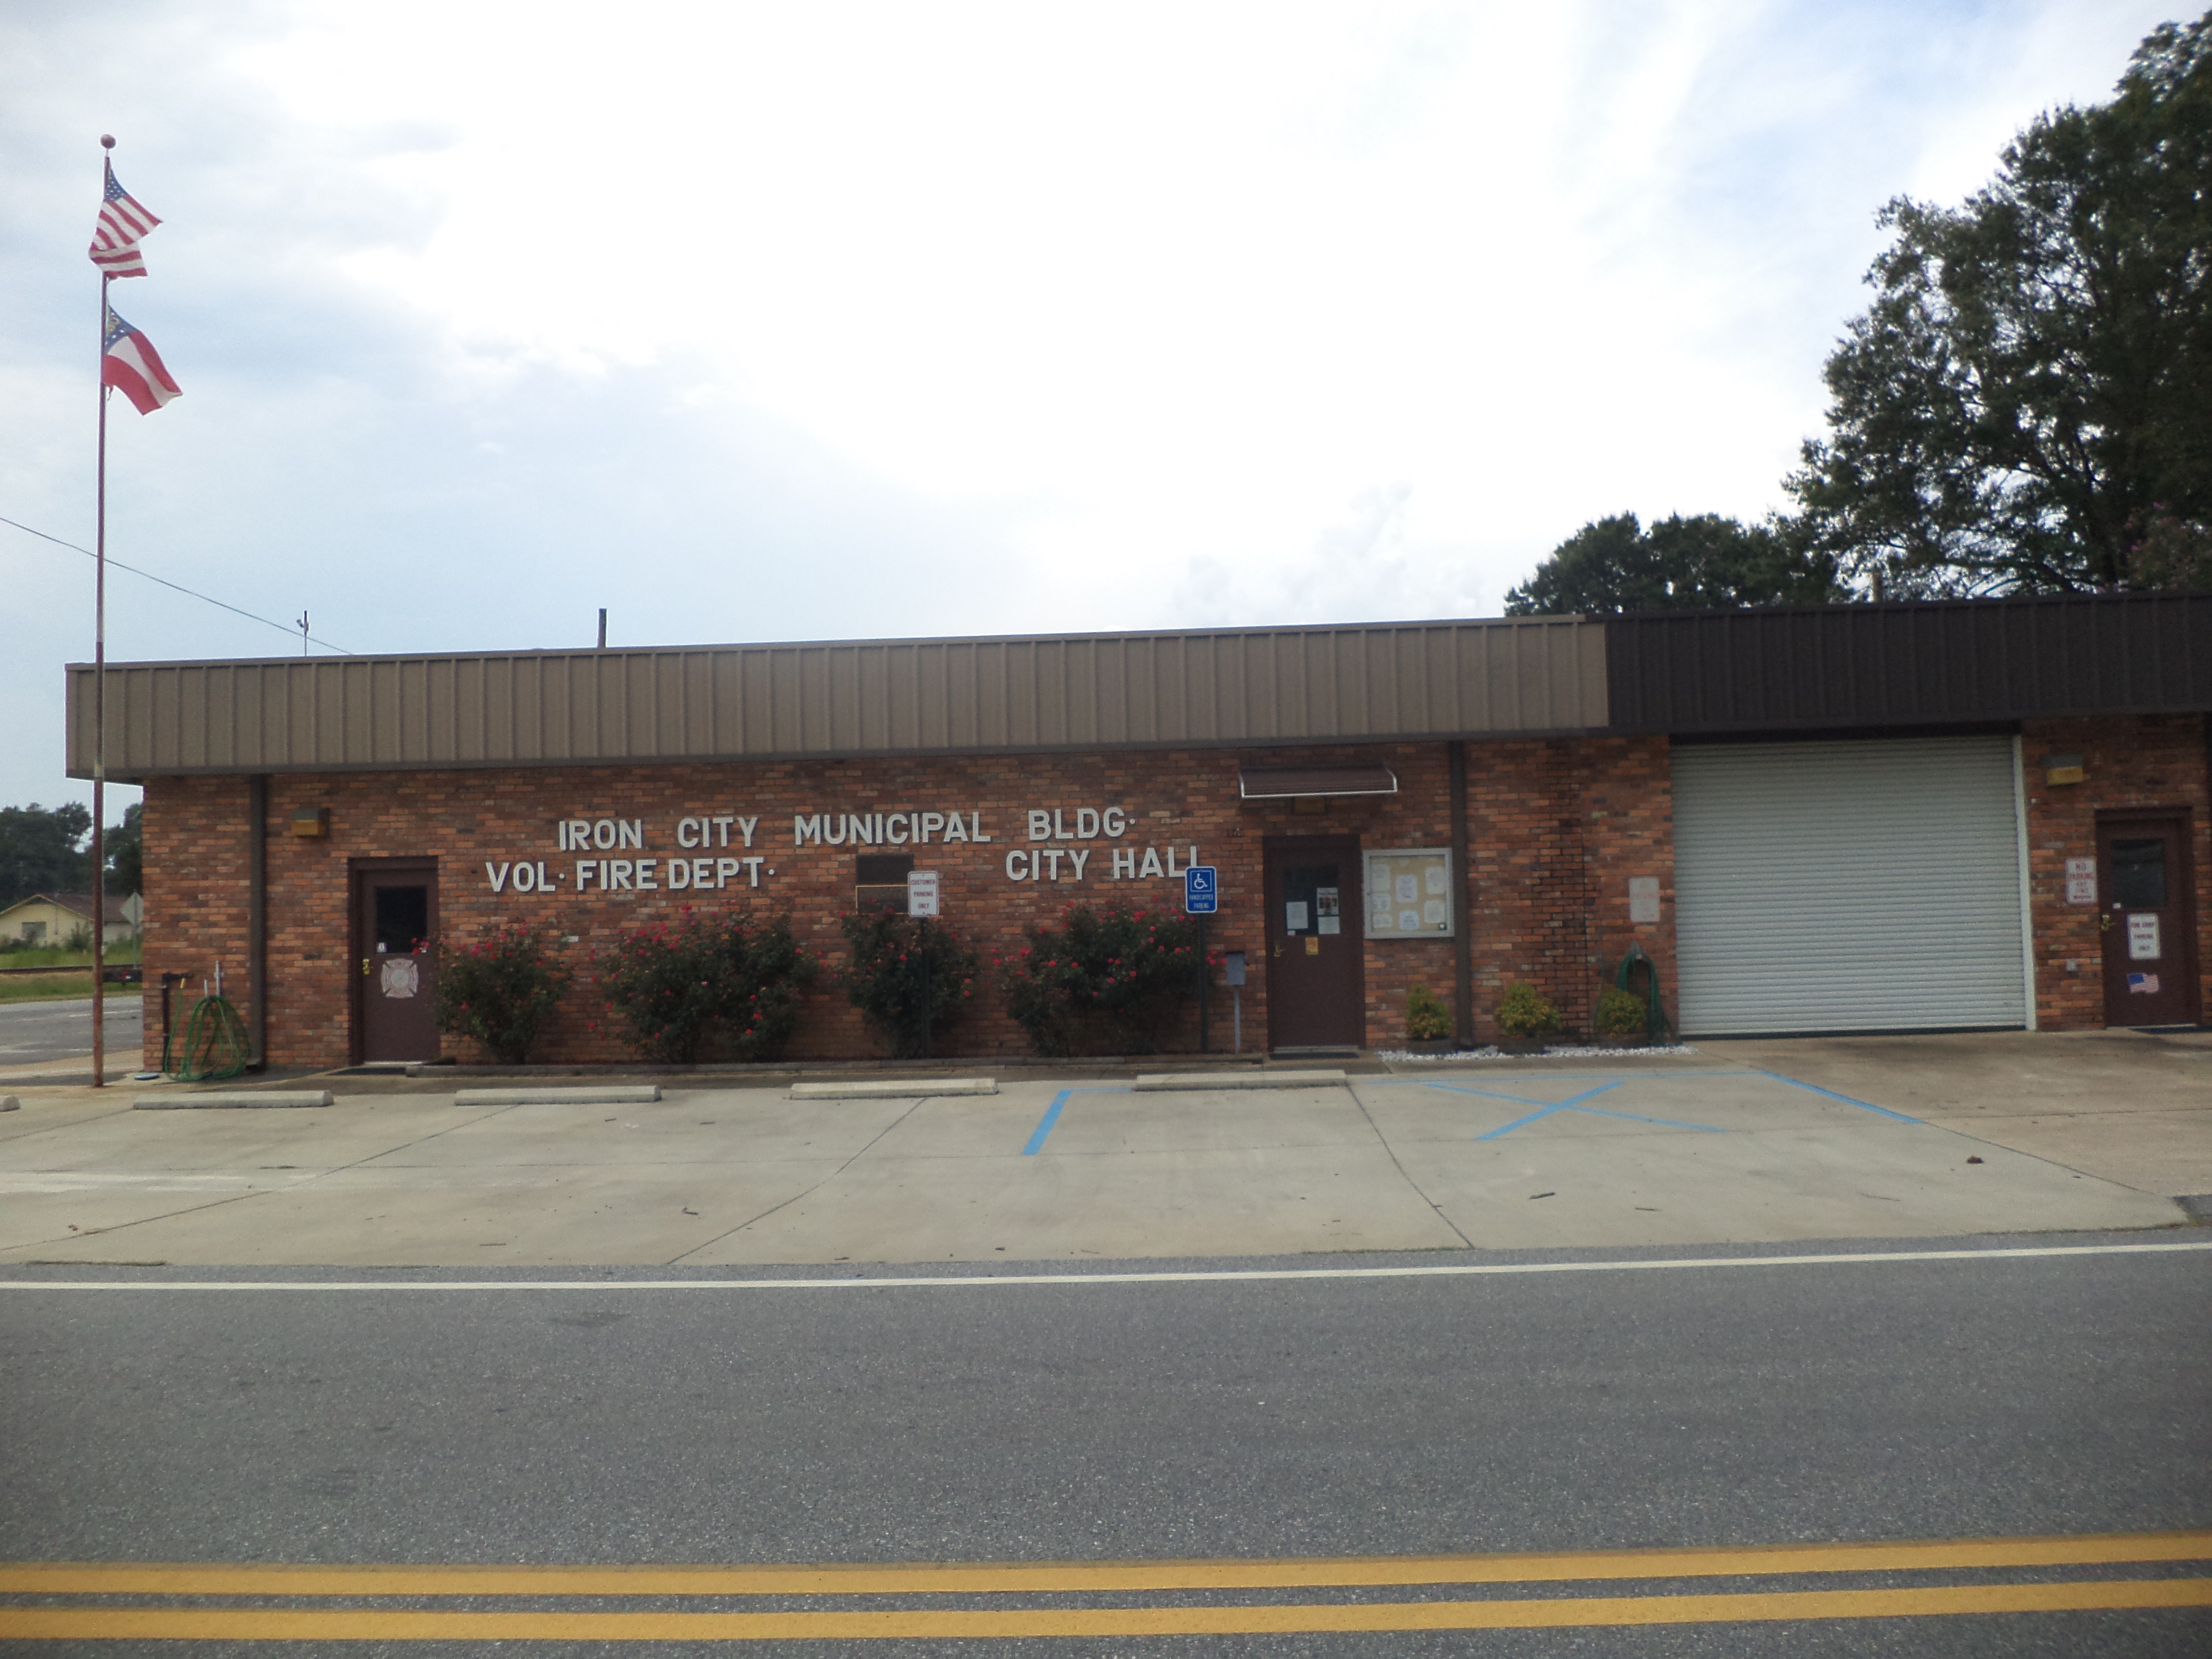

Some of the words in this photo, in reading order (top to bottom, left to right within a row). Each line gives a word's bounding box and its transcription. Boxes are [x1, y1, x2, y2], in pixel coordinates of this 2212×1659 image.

[559, 819, 642, 850] IRON
[677, 817, 758, 847] CITY
[794, 812, 991, 845] MUNICIPAL
[577, 859, 657, 890] FIRE
[1006, 849, 1089, 881] CITY
